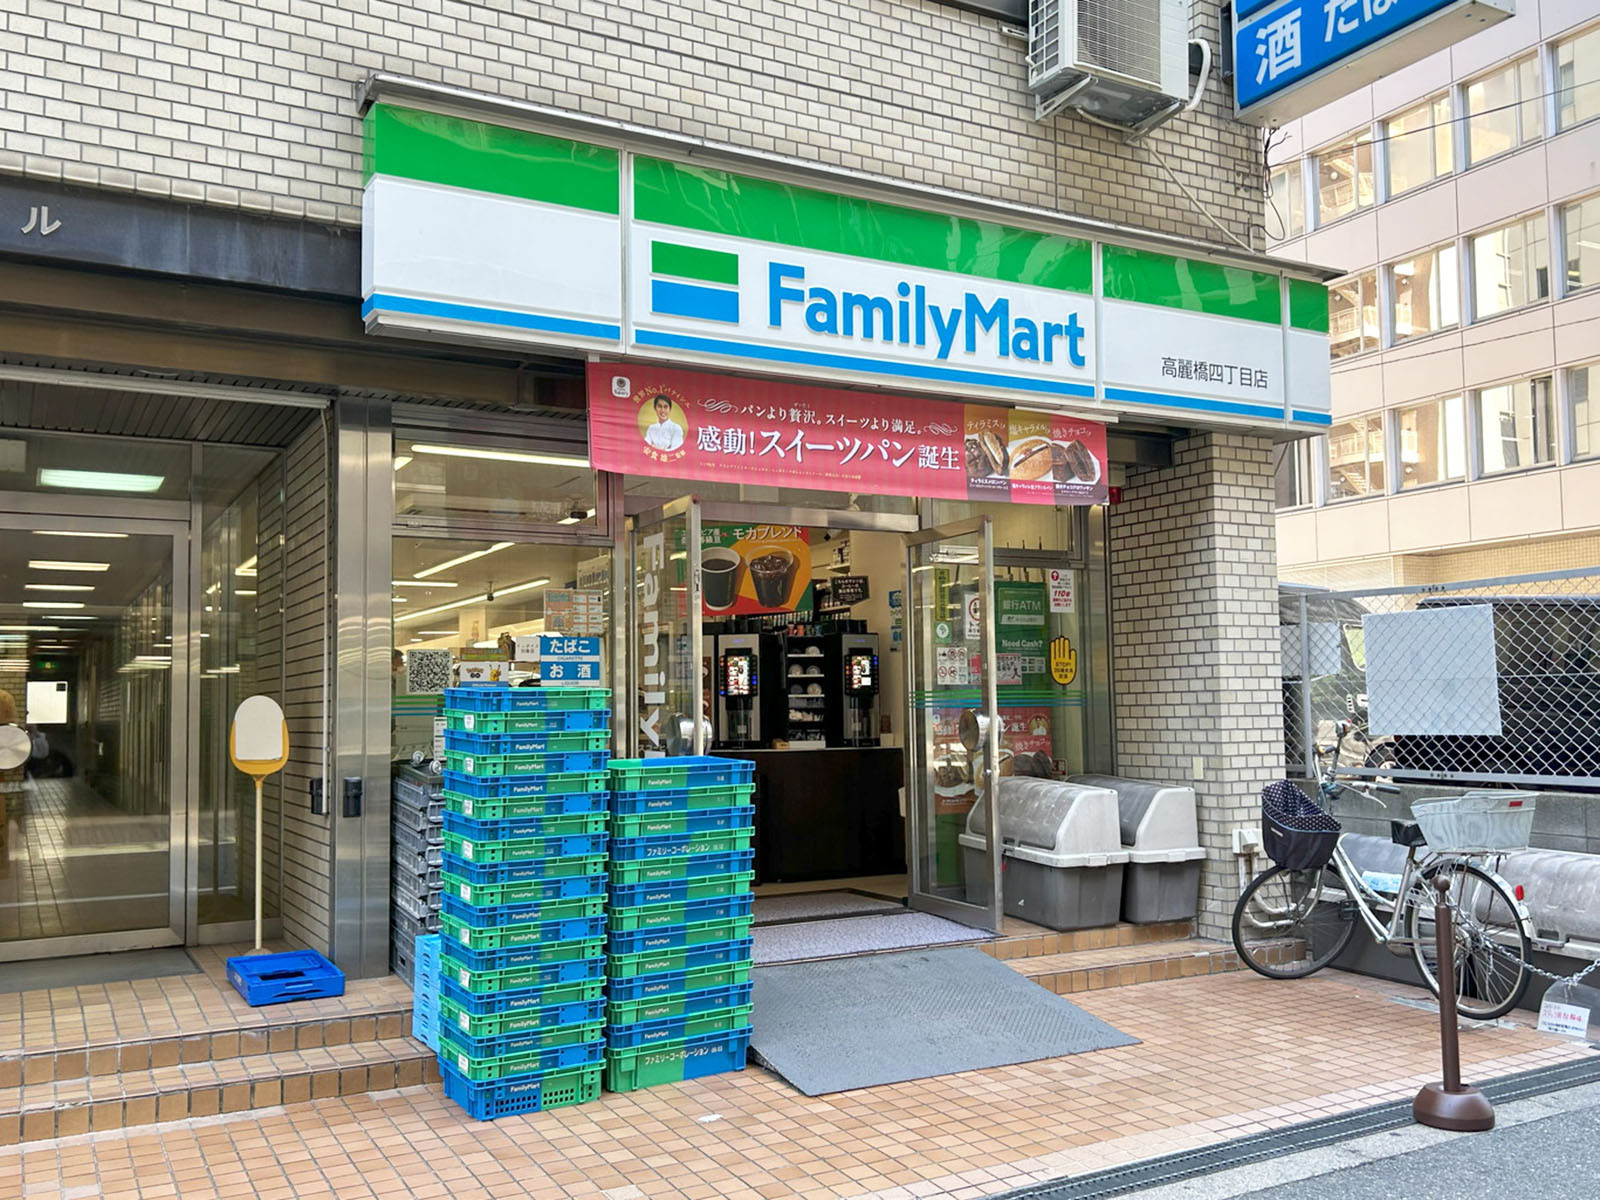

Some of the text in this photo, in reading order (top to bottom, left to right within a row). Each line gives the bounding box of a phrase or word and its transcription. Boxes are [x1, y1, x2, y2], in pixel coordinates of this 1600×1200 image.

[1255, 7, 1302, 86] 酒
[20, 205, 62, 236] ル
[768, 261, 1086, 367] FamilyMart
[1161, 356, 1269, 390] 高麗橋四丁目店
[740, 405, 922, 437] パンより贅沢。スイーツより満足。
[732, 526, 802, 541] モカブレンド
[549, 638, 591, 654] たばこ
[1002, 639, 1020, 648] Need
[1021, 639, 1043, 649] Cash?
[515, 743, 546, 751] FamilyMart
[514, 763, 545, 771] FamilyMart
[513, 785, 544, 793] FamilyMart
[513, 806, 543, 814] FamilyMart
[511, 911, 541, 920] FamilyMart
[510, 933, 540, 942] FamilyMart
[645, 938, 670, 946] FamilyMart
[645, 961, 670, 969] FamilyMart
[645, 983, 670, 992] FamilyMart
[510, 998, 540, 1006] FamilyMart
[645, 1006, 670, 1015] FamilyMart
[509, 1019, 540, 1028] FamilyMart
[644, 1031, 669, 1039] FamilyMart
[510, 1062, 540, 1071] FamilyMart
[510, 1082, 540, 1092] FamilyMart
